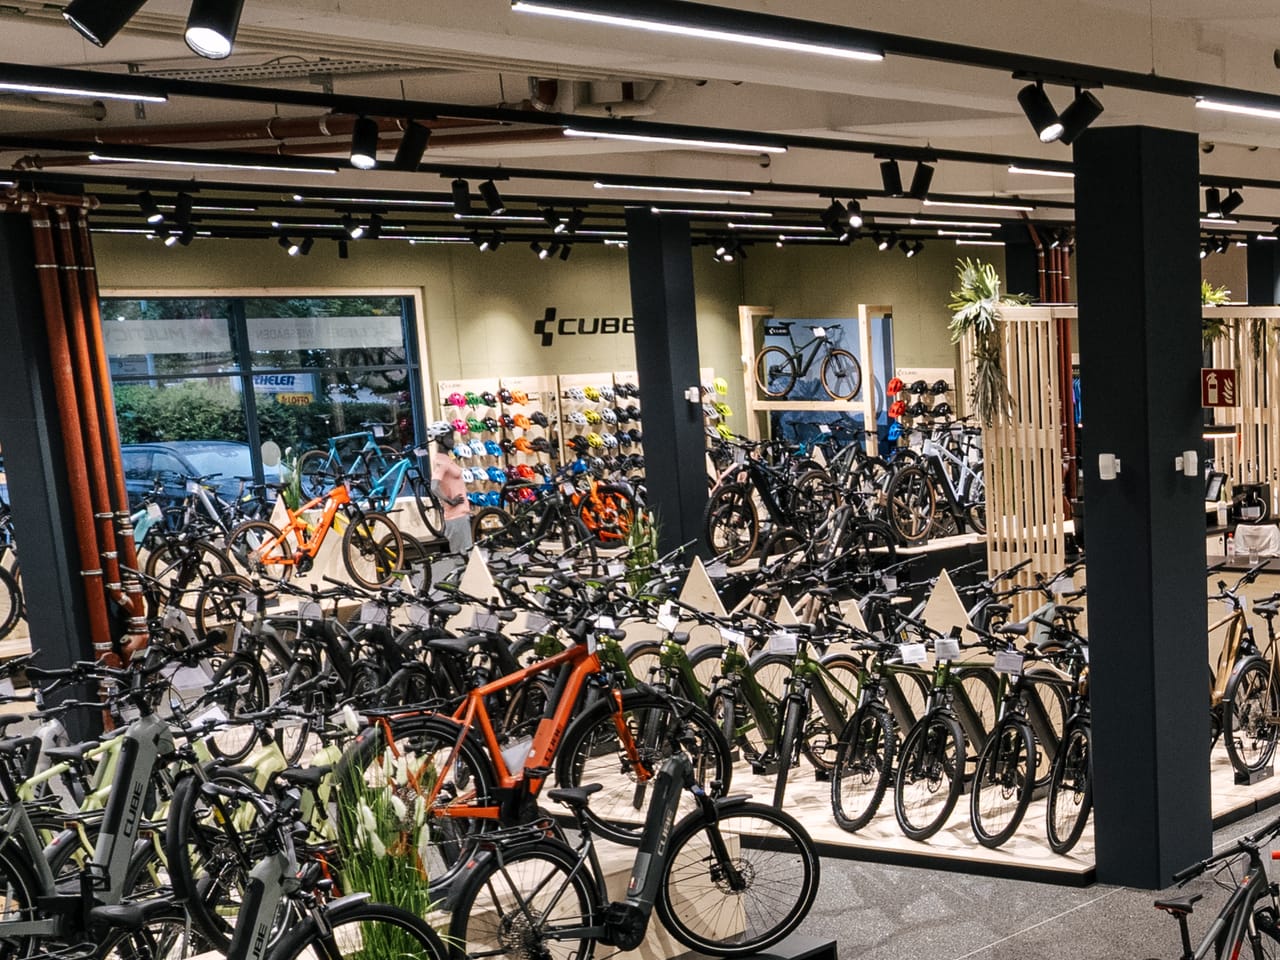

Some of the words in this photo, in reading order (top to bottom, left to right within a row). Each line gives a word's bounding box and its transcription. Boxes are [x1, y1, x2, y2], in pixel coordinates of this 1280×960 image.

[557, 316, 636, 336] CUBE
[123, 781, 144, 838] CUBE
[657, 809, 674, 857] CUBE
